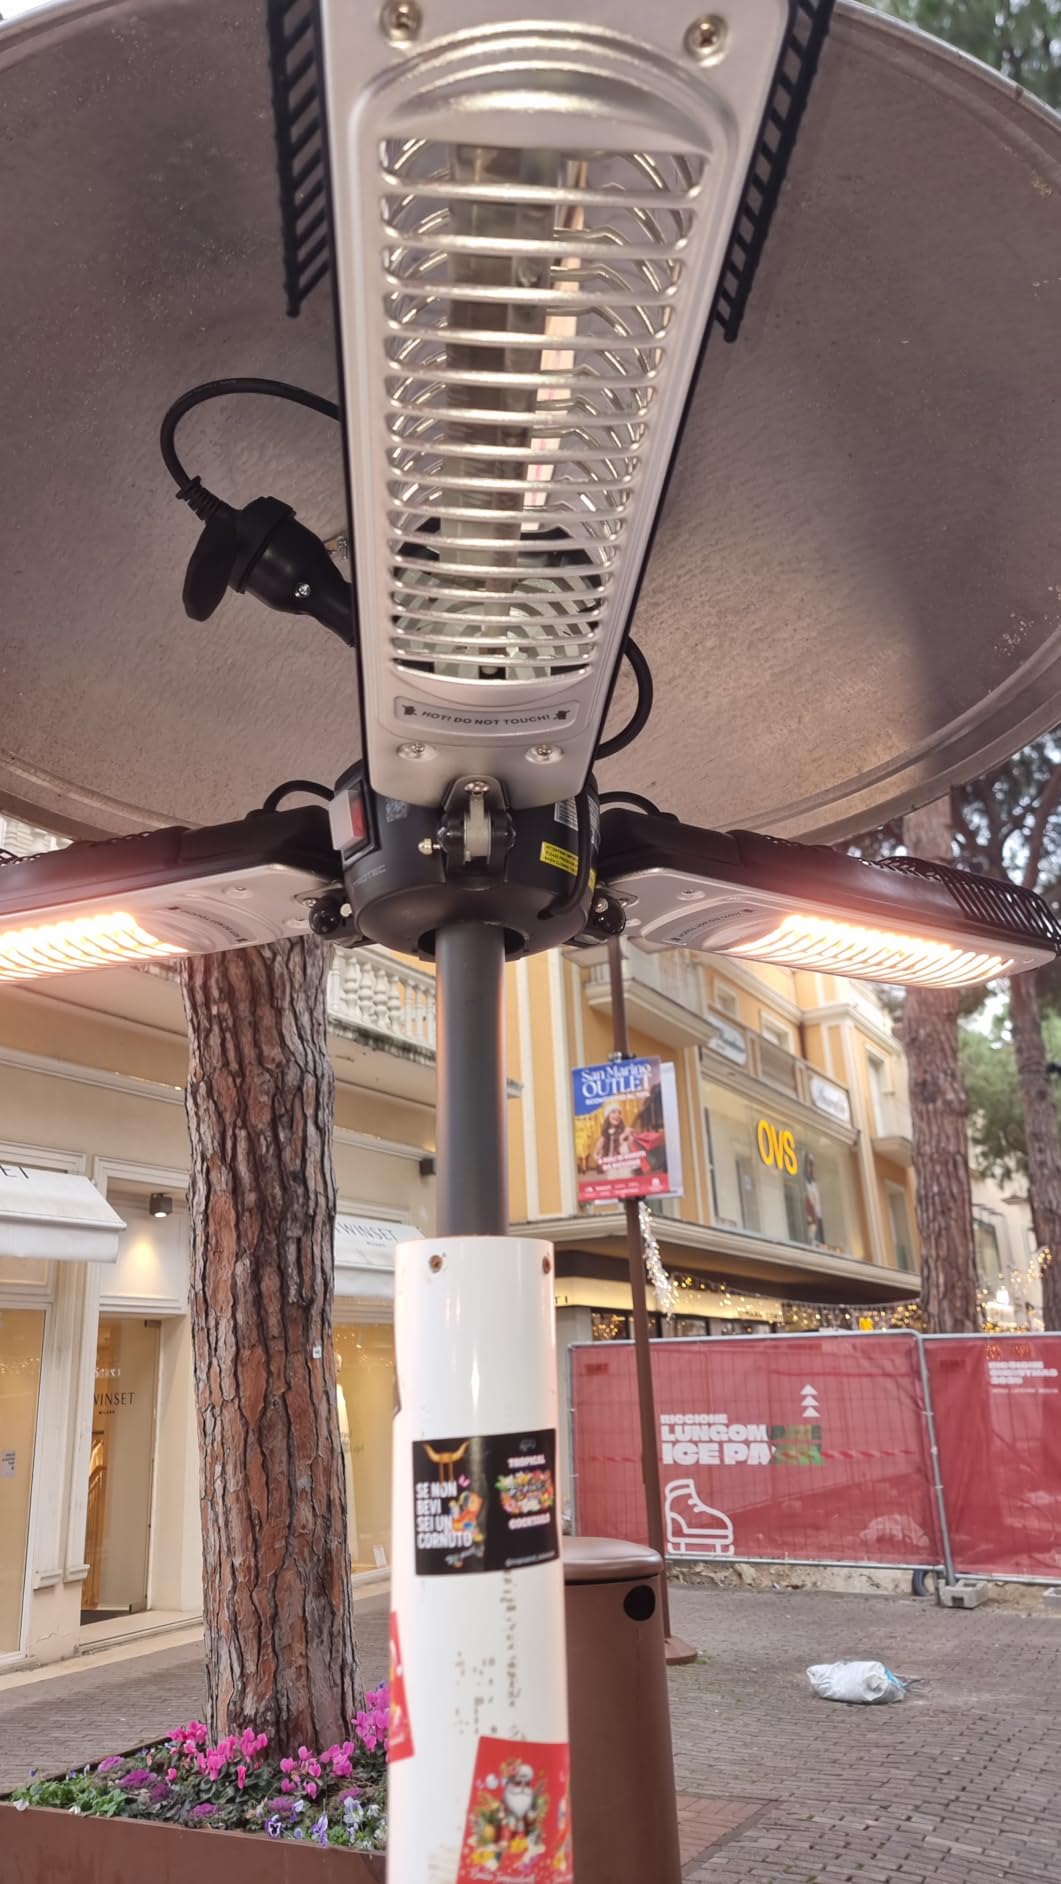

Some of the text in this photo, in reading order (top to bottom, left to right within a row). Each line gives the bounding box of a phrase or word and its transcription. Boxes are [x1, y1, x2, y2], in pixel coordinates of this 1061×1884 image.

[422, 710, 452, 721] HOT!
[504, 714, 551, 725] TOUCH!
[581, 1062, 653, 1082] San Marino
[582, 1073, 651, 1098] OUTLET
[757, 1119, 799, 1176] OVS
[660, 1414, 728, 1424] RICCIONE
[662, 1443, 720, 1465] ICE
[415, 1480, 458, 1498] SE NON
[415, 1499, 442, 1515] BEVI
[416, 1514, 453, 1532] SEI UN
[417, 1532, 472, 1550] CORNUTO
